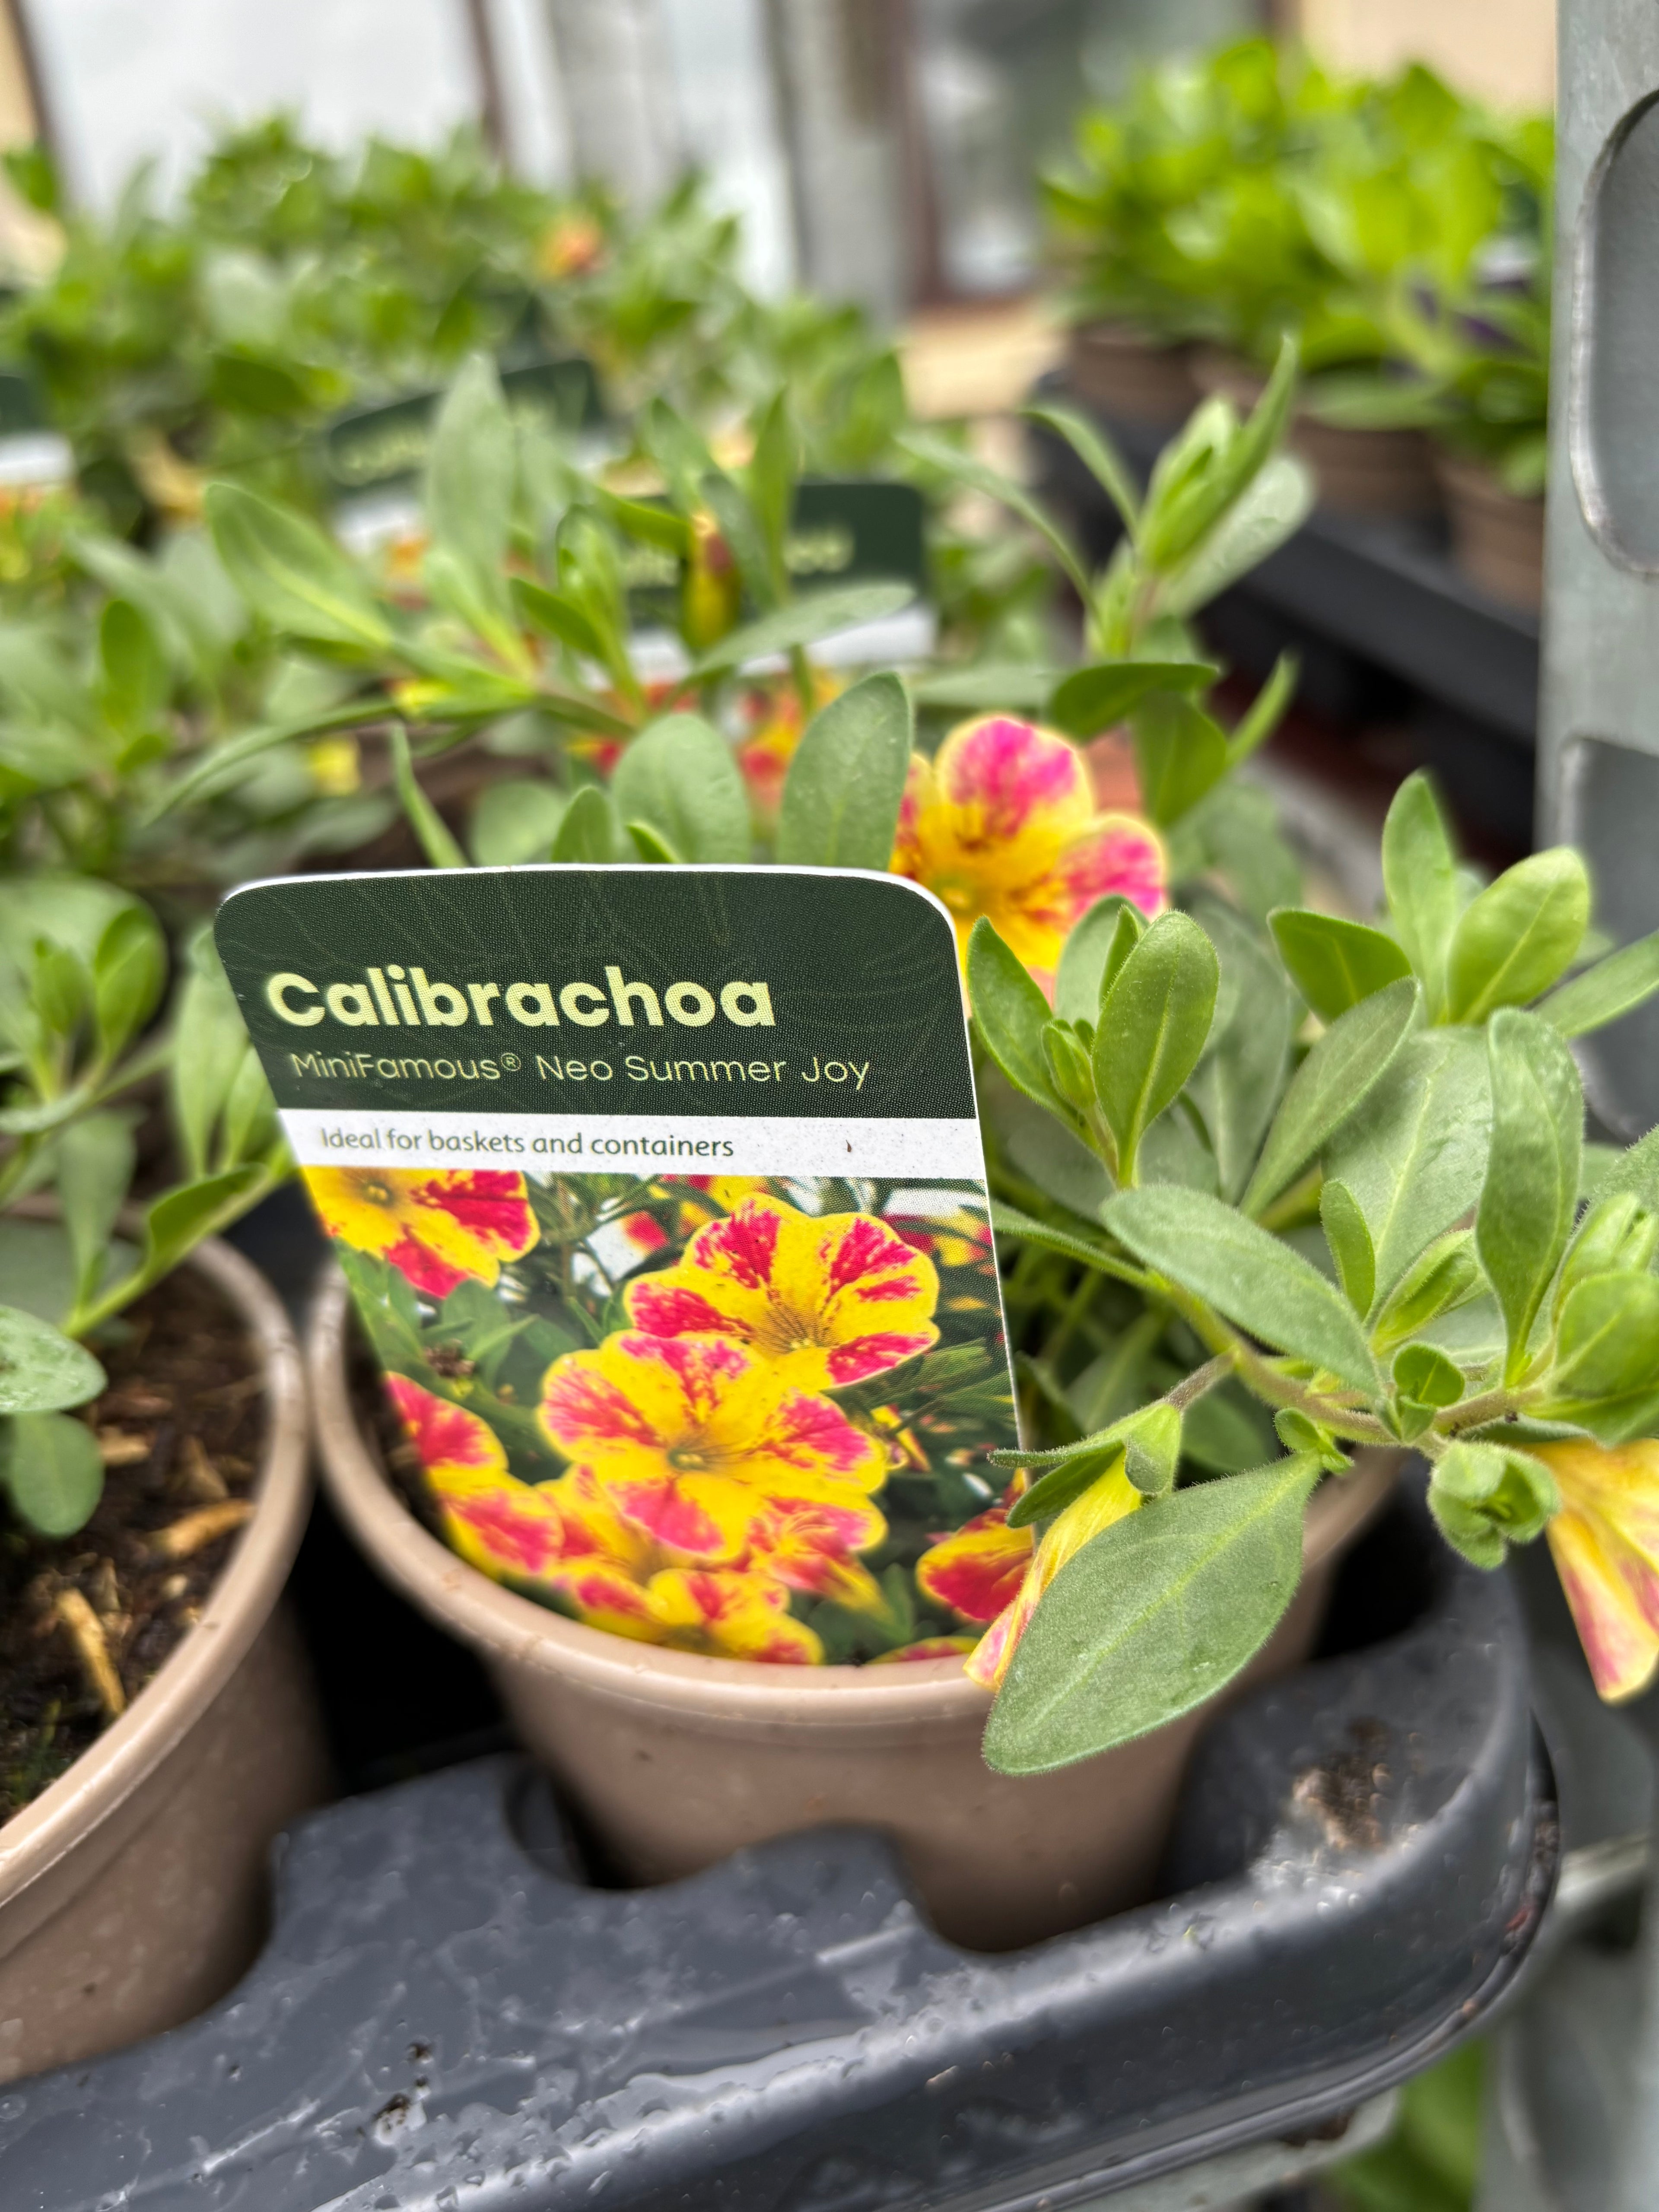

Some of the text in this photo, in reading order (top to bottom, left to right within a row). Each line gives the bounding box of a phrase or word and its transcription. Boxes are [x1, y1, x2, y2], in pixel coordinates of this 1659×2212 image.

[267, 964, 776, 1027] Calibrachoa
[536, 1055, 613, 1081] Neo
[625, 1055, 786, 1081] Summer
[801, 1057, 870, 1090] Joy
[321, 1128, 734, 1157] Ideal for baskets and containers
